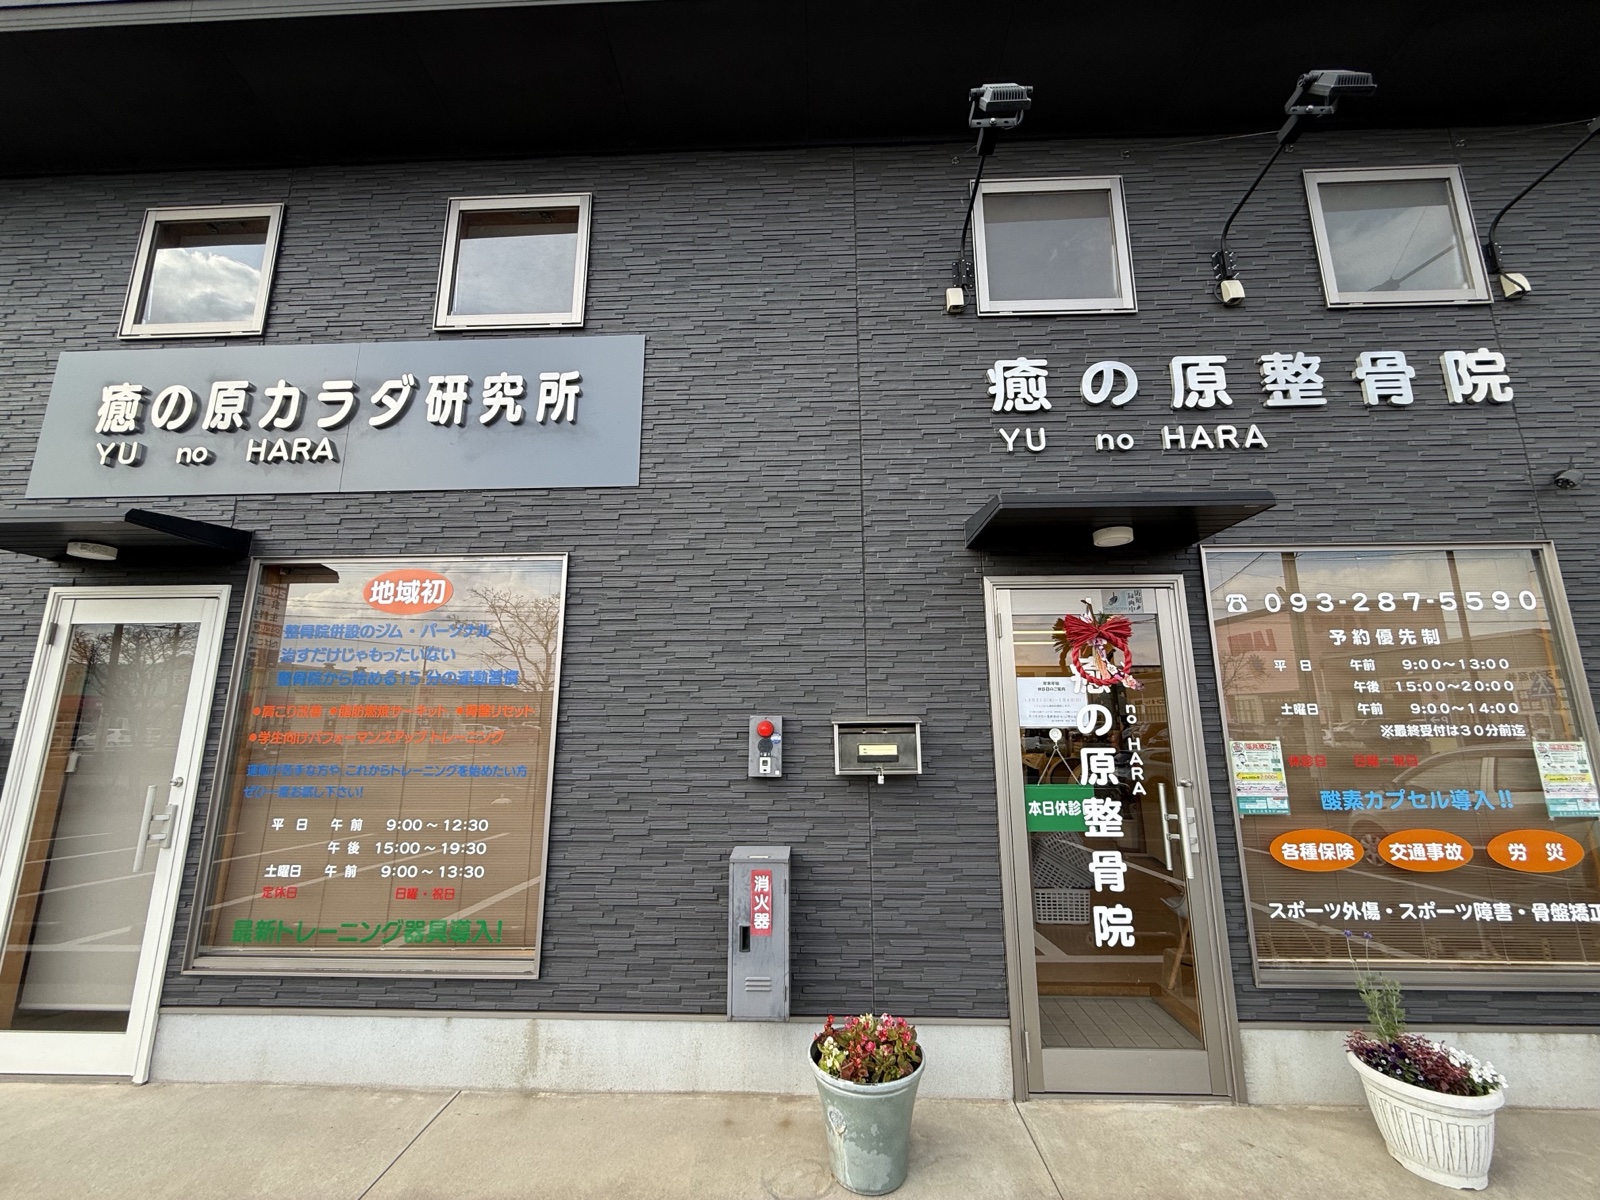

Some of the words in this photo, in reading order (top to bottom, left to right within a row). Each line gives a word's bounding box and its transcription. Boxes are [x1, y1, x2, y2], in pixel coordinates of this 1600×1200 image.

[987, 348, 1514, 412] 癒の原整骨院
[95, 371, 583, 433] 癒の原カラダ研究所
[1000, 427, 1046, 453] YU
[1096, 432, 1135, 451] no
[1161, 424, 1269, 451] HARA
[97, 441, 139, 465] YU
[176, 446, 208, 464] no
[246, 437, 334, 462] HARA
[369, 579, 446, 605] 地域初
[1264, 590, 1537, 613] 093-287-5590
[1329, 628, 1441, 646] 予約優先制
[279, 646, 457, 663] 治すだけじゃもったいない
[1350, 658, 1376, 672] 午前
[1353, 680, 1381, 693] 午後
[1125, 704, 1138, 724] no
[1281, 703, 1319, 715] 土曜日
[1357, 703, 1384, 715] 午前
[1128, 737, 1146, 796] HARA
[1028, 800, 1082, 816] 本日休診
[1281, 843, 1355, 861] 各種保険
[1390, 843, 1465, 861] 交通事故
[263, 864, 302, 877] 土曜日
[261, 886, 298, 899] 定休日
[754, 875, 770, 929] 消火器
